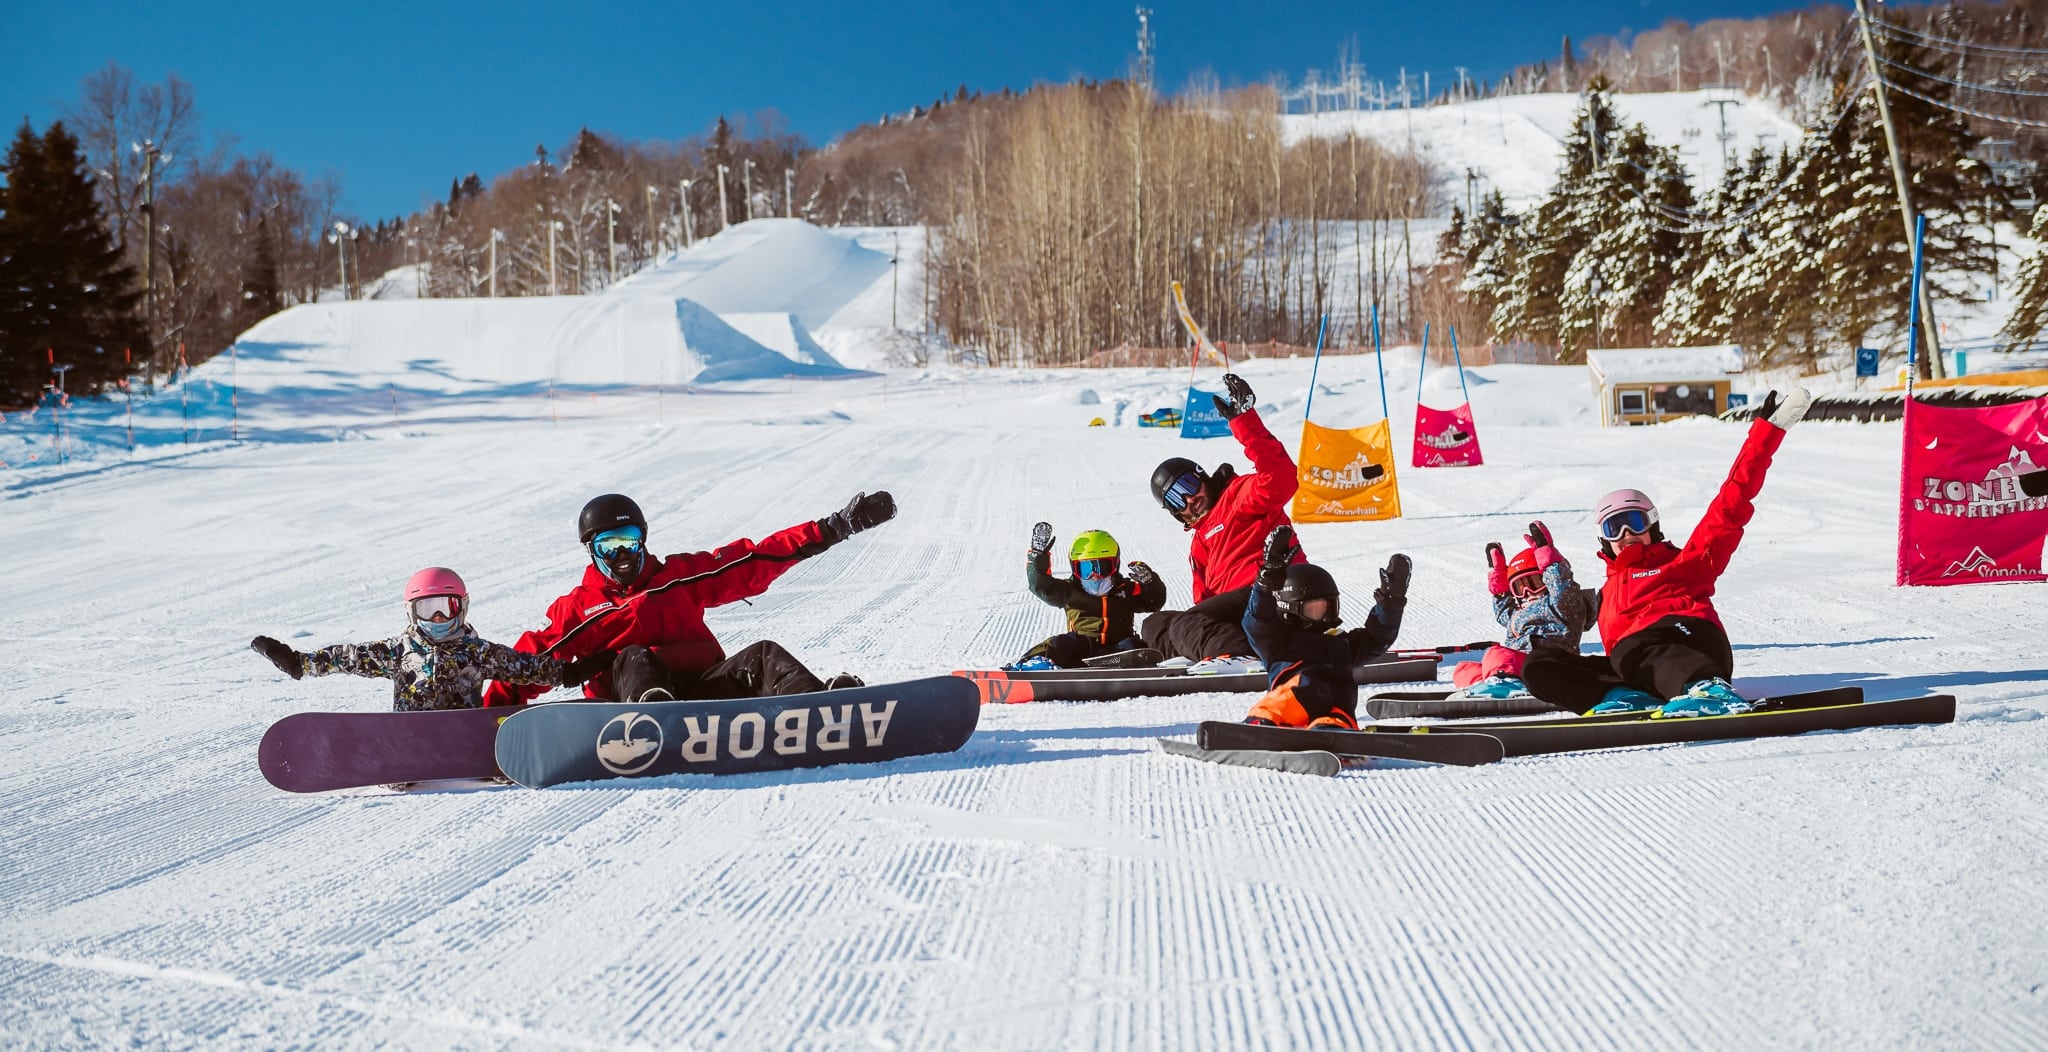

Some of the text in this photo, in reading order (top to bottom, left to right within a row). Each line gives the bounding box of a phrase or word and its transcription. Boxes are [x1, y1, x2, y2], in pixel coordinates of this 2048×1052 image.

[1311, 466, 1360, 481] ZONE
[1923, 477, 2016, 502] ZONE
[1914, 497, 2048, 518] D'APPRENTISS
[681, 700, 898, 762] ARBOR
